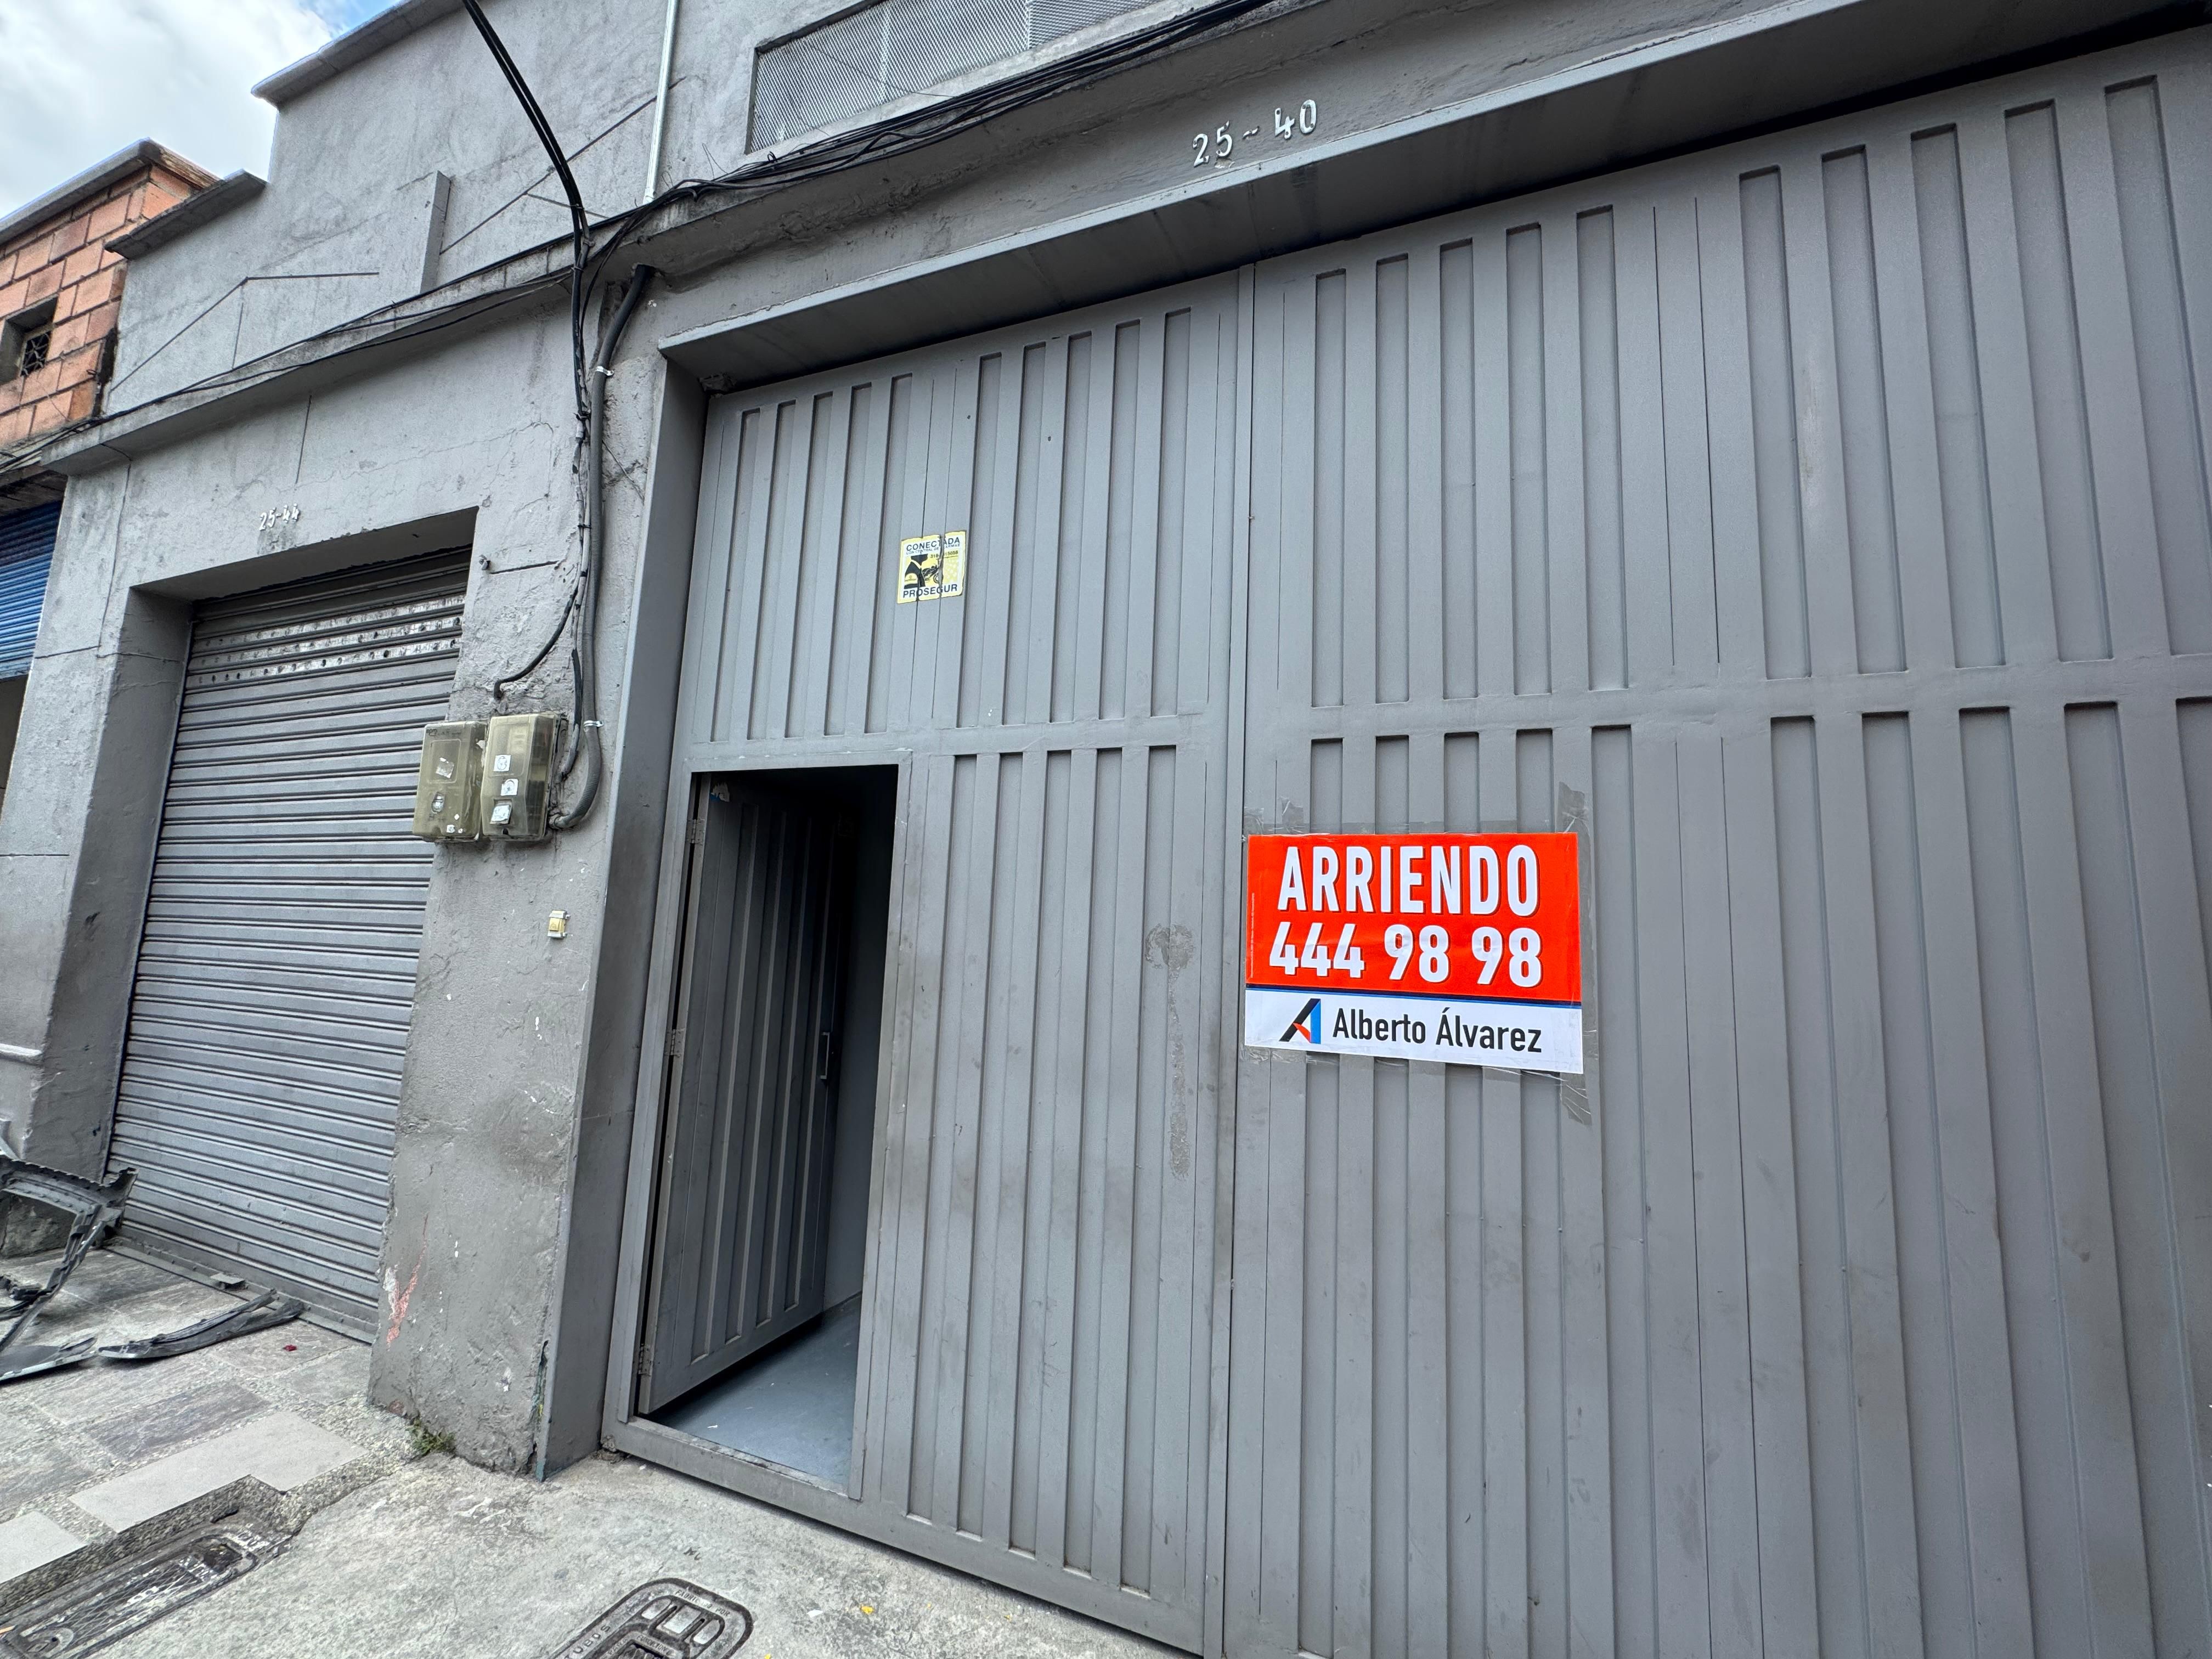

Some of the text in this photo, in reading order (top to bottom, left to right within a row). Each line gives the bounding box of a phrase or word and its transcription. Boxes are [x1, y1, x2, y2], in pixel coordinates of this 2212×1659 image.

[259, 503, 300, 531] 25-44
[903, 584, 957, 598] PROSEGUR
[1277, 844, 1539, 917] ARRIENDO
[1269, 921, 1365, 978] 444
[1384, 924, 1450, 983] 98
[1472, 926, 1542, 988] 98
[1333, 1007, 1542, 1053] Alberto Álvarez
